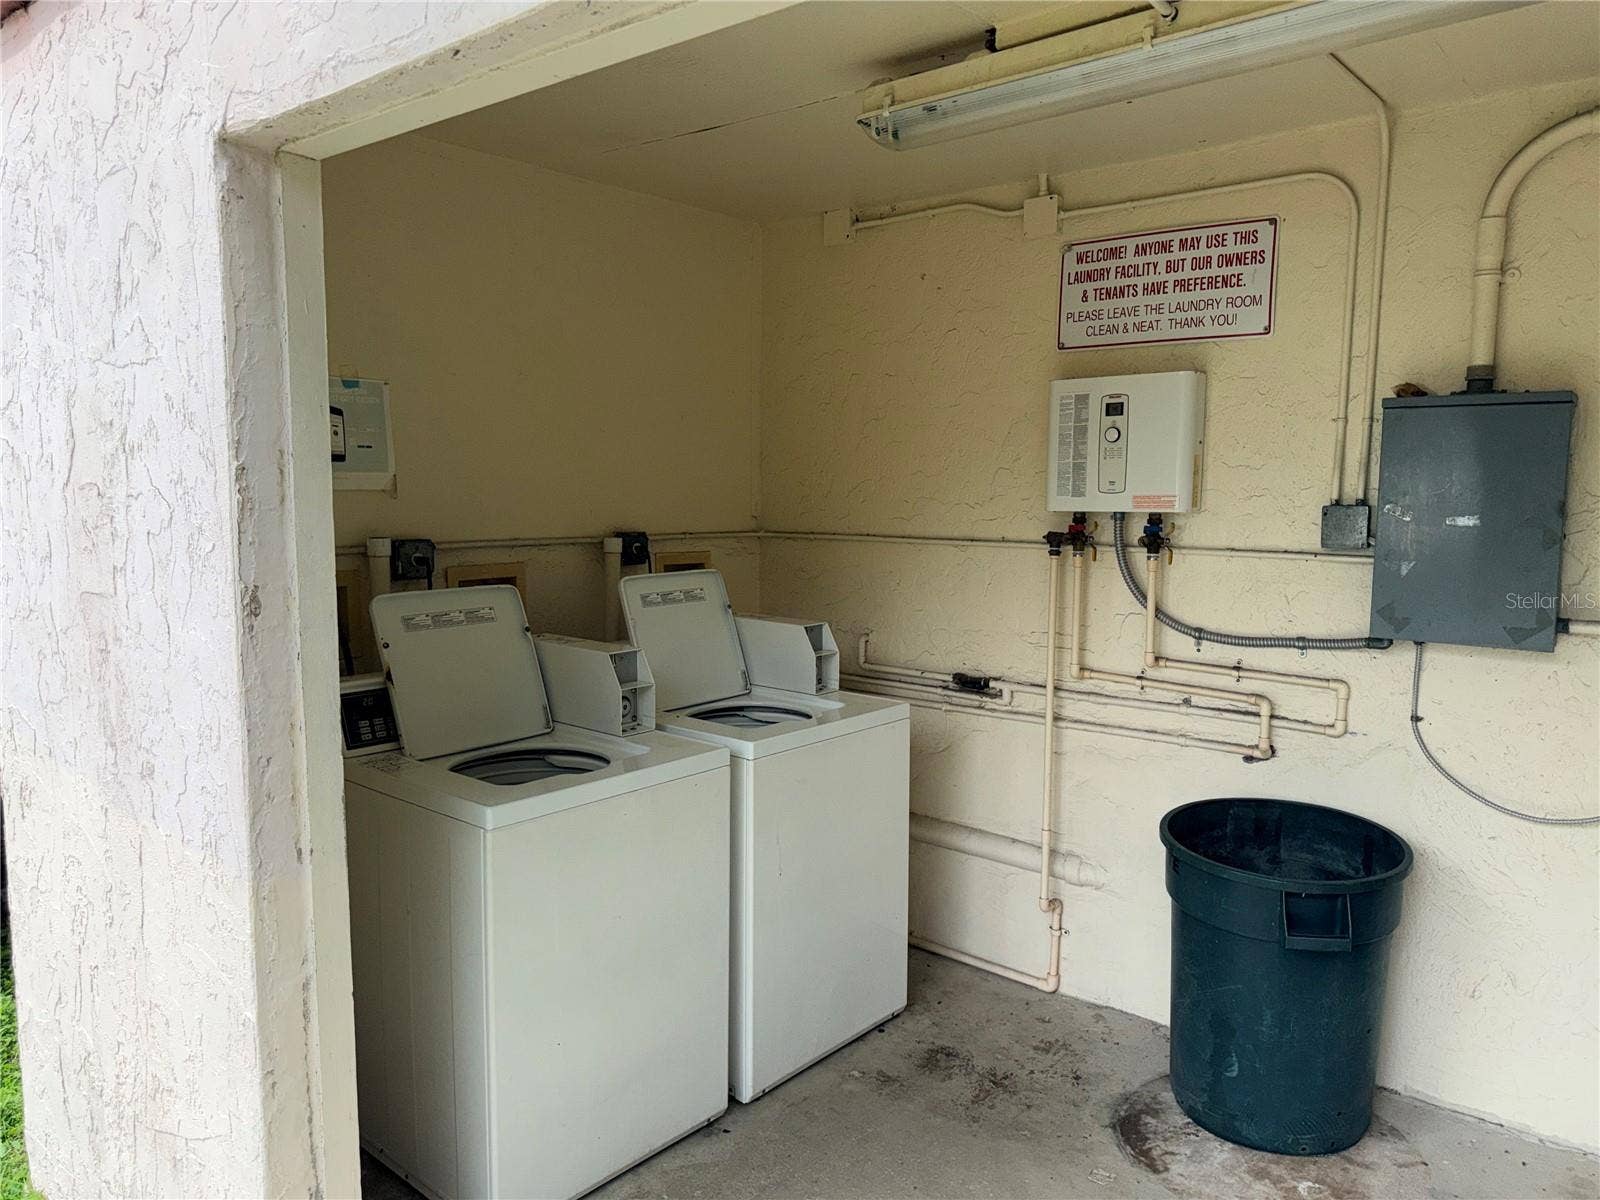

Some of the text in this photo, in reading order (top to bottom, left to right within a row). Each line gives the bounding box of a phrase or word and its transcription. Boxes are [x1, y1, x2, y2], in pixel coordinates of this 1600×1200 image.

[1076, 230, 1259, 265] WELCOME! ANYONE MAY USE THIS
[1067, 266, 1111, 285] LAUNDRY
[1165, 258, 1187, 274] BUT
[1190, 255, 1213, 271] OUR
[1217, 249, 1266, 269] OWNERS
[1081, 273, 1246, 303] & TENANTS HAVE PREFERENCE.
[1066, 294, 1263, 323] PLEASE LEAVE THE LAUNDRY ROOM
[1085, 313, 1238, 337] CLEAN & NEAT. THANK YOU!
